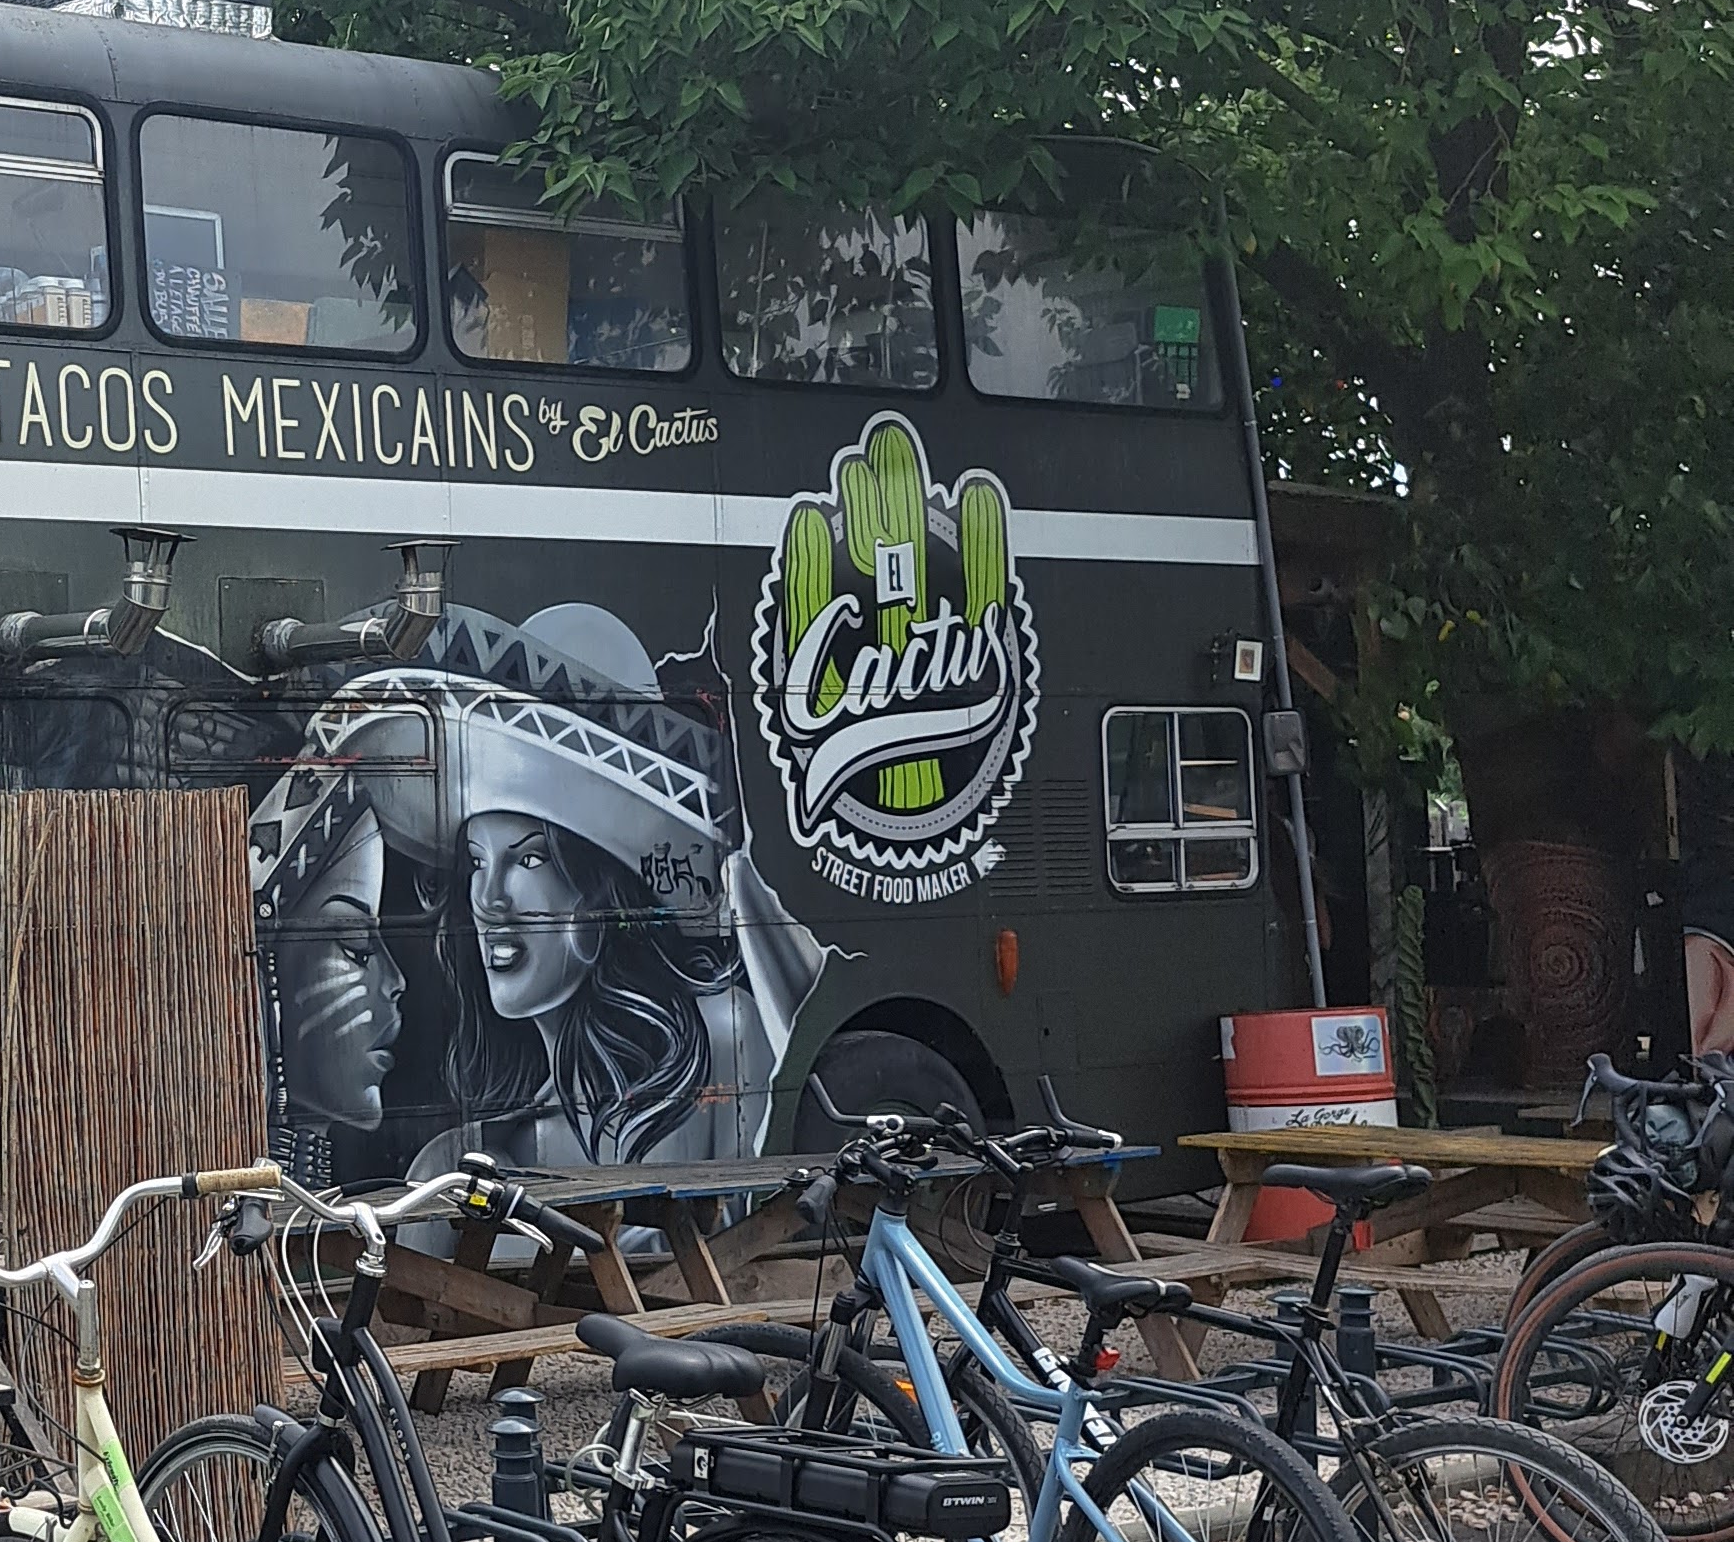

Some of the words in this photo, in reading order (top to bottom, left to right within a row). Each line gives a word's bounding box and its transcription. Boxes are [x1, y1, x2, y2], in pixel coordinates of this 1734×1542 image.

[151, 289, 169, 326] BUS
[222, 374, 535, 474] MEXICAINS
[538, 396, 570, 436] by
[572, 404, 624, 462] El
[628, 404, 719, 455] Cactus
[887, 552, 904, 592] EL
[784, 593, 1005, 731] Cactus
[811, 846, 873, 898] STREET
[872, 875, 914, 904] FOOD
[916, 861, 973, 903] MAKER
